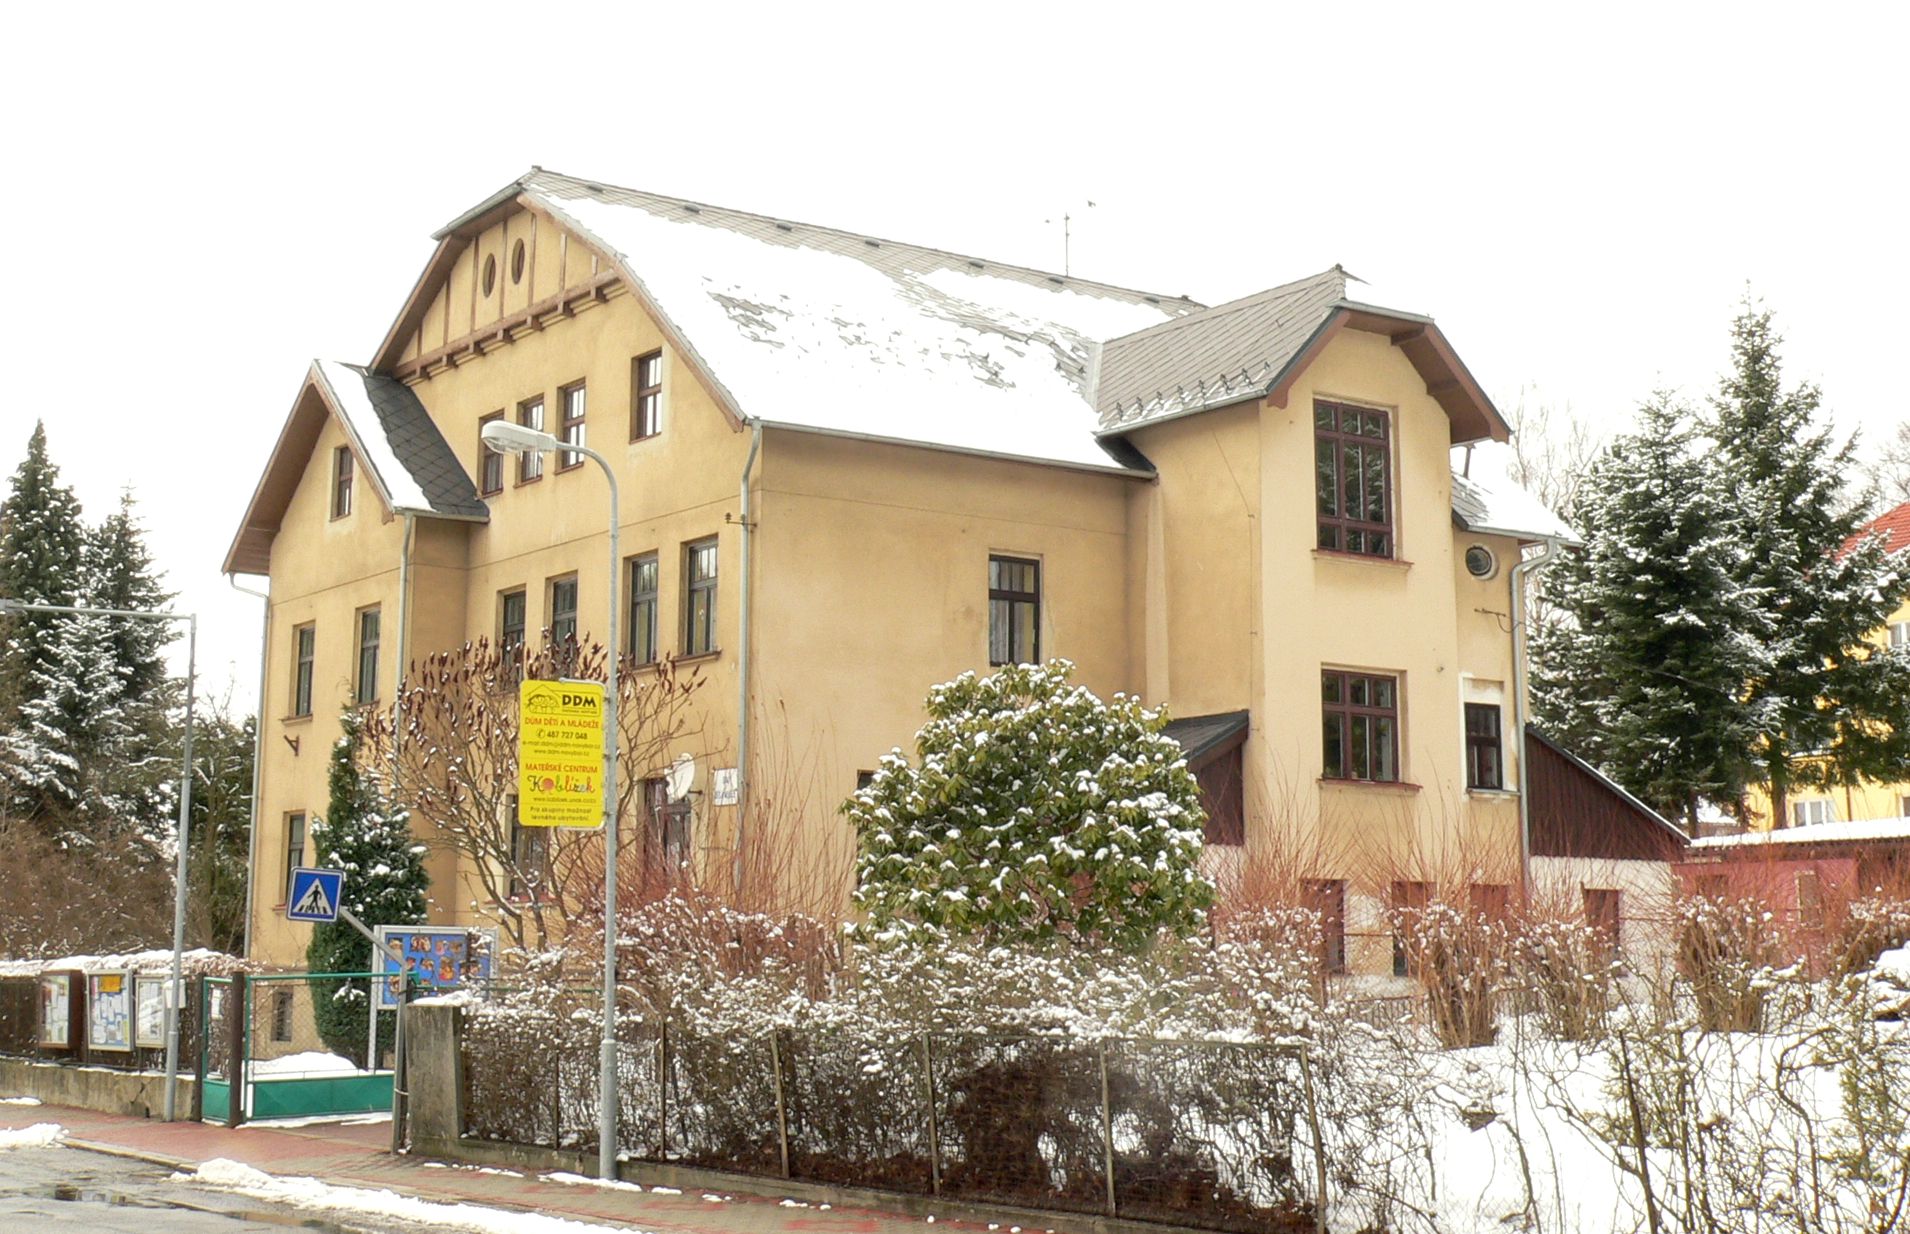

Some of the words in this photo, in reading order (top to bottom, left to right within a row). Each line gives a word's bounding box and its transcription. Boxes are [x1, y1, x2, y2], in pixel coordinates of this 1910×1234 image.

[562, 694, 596, 707] DDM
[567, 719, 599, 728] MLÁDEŽE
[547, 730, 559, 738] 487
[561, 731, 574, 739] 727
[525, 763, 561, 772] MATEŘSKÉ
[563, 765, 598, 773] CENTRUM
